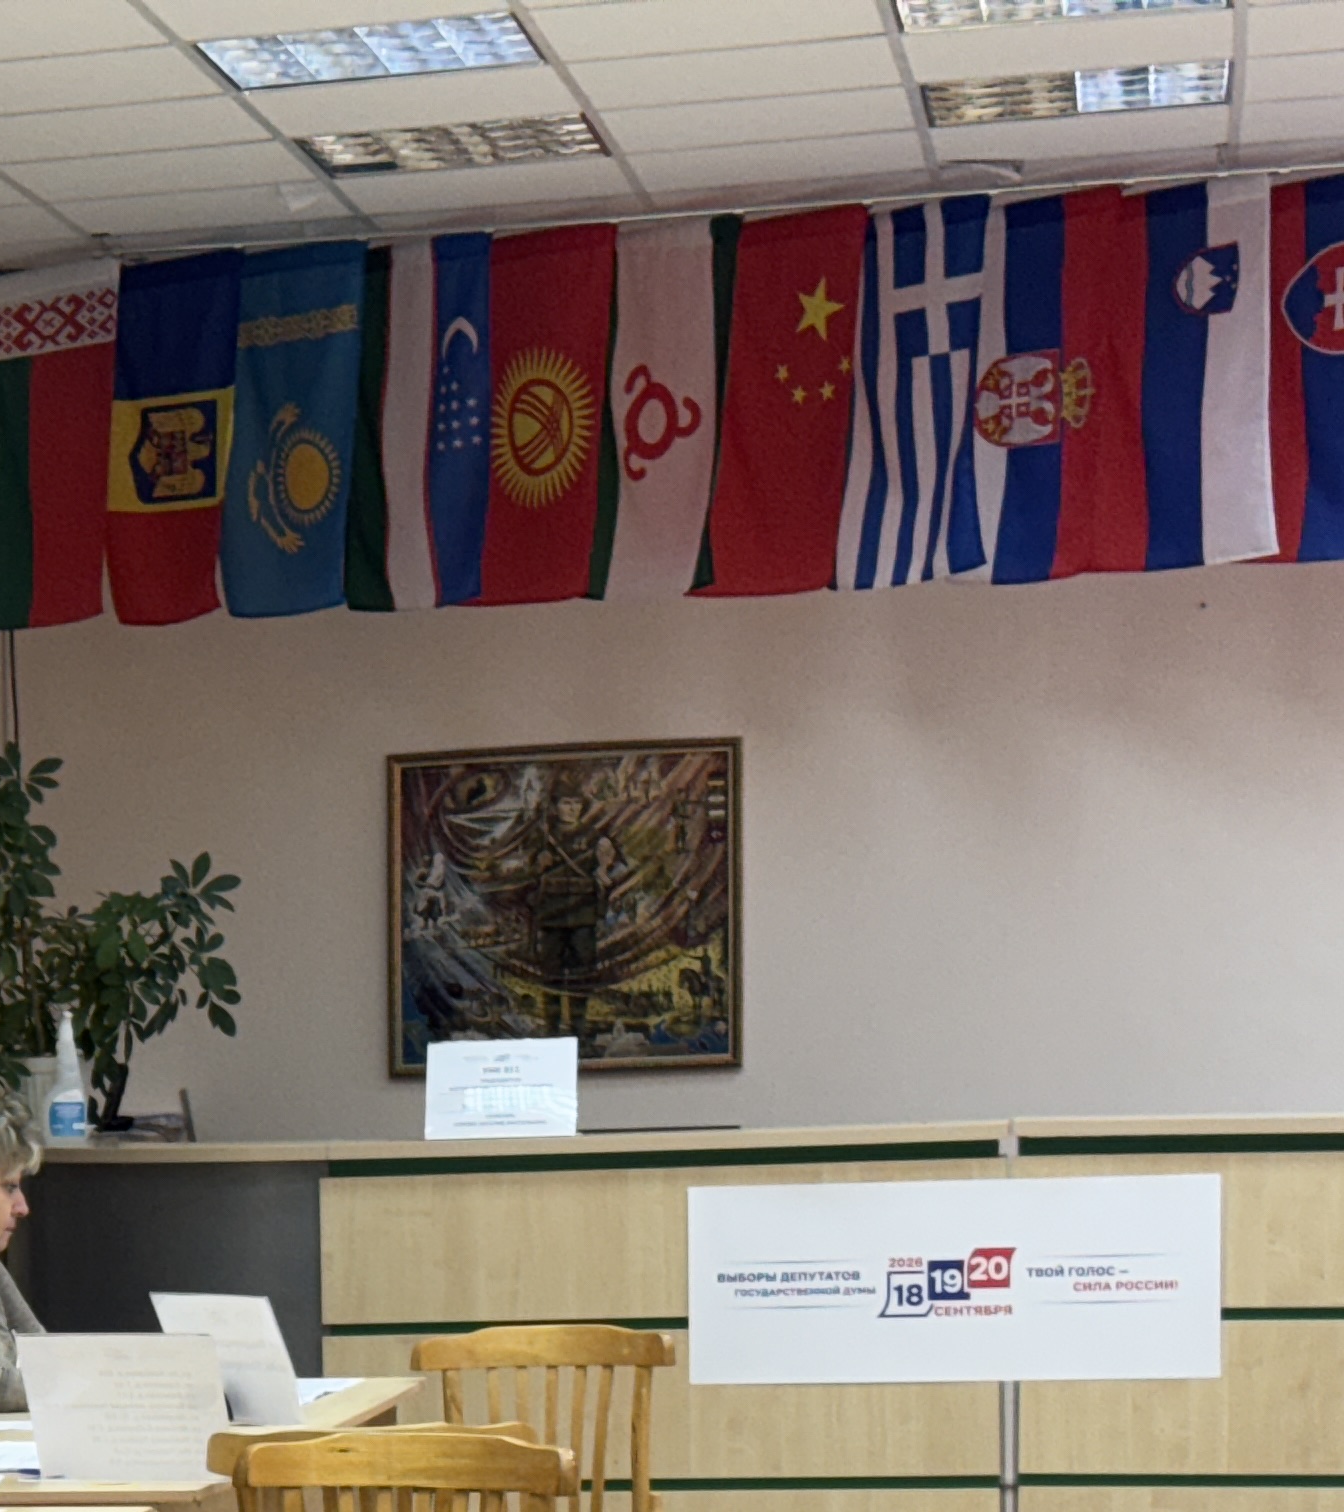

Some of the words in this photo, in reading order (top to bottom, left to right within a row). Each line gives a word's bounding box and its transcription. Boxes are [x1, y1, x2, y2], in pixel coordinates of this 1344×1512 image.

[969, 1255, 1009, 1281] 20
[1027, 1265, 1065, 1277] ТВОЙ
[1068, 1266, 1115, 1276] ГОЛОС
[717, 1272, 777, 1283] ВЫБОРЫ
[780, 1270, 861, 1283] ДЕПУТАТОВ
[931, 1268, 963, 1294] 19
[1073, 1281, 1112, 1292] СИЛА
[893, 1284, 924, 1306] 18
[934, 1305, 1014, 1317] СЕНТЯБРЯ
